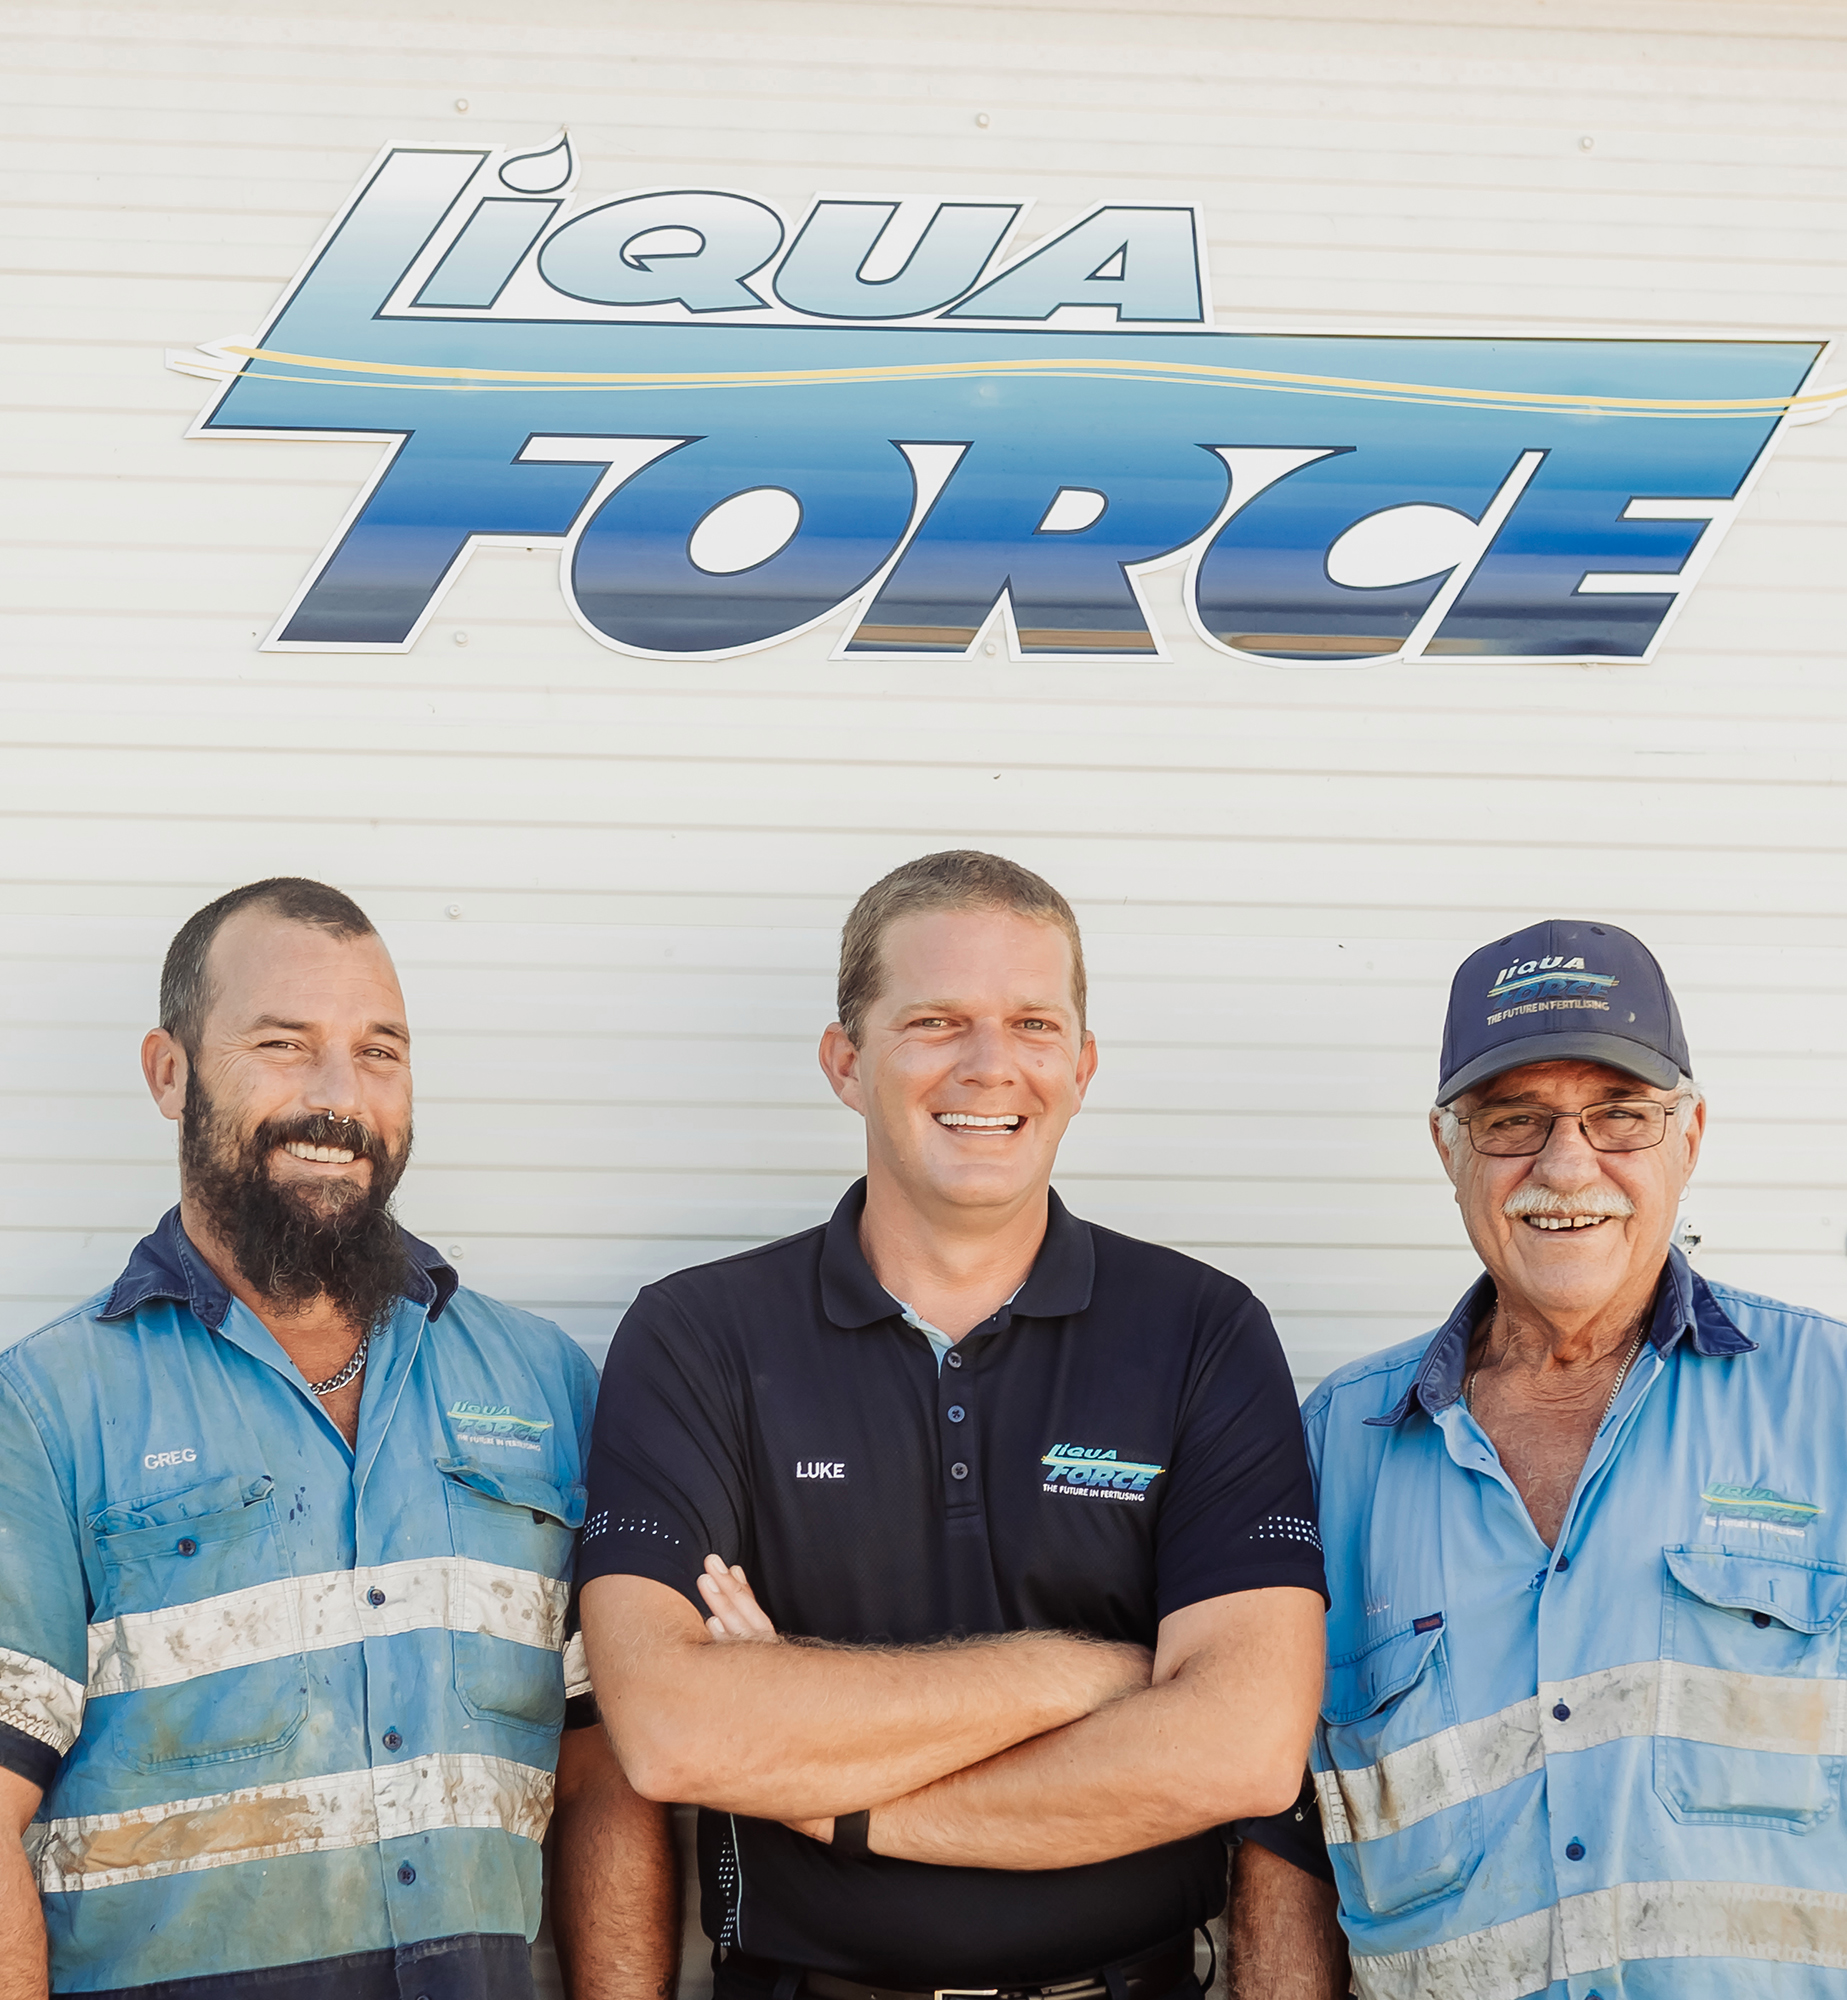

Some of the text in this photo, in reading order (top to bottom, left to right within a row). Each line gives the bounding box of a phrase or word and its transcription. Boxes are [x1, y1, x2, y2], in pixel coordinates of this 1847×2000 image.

[203, 330, 1827, 660] FORCE
[1492, 972, 1616, 1012] FORCE
[1487, 999, 1610, 1026] THE FUTURE IN FERTILISING
[456, 1416, 549, 1443] FORCE
[144, 1447, 197, 1470] GREG
[796, 1461, 845, 1479] LUKE
[1042, 1460, 1162, 1491] FORCE
[1042, 1483, 1146, 1502] THE FUTURE IN FERTILISING
